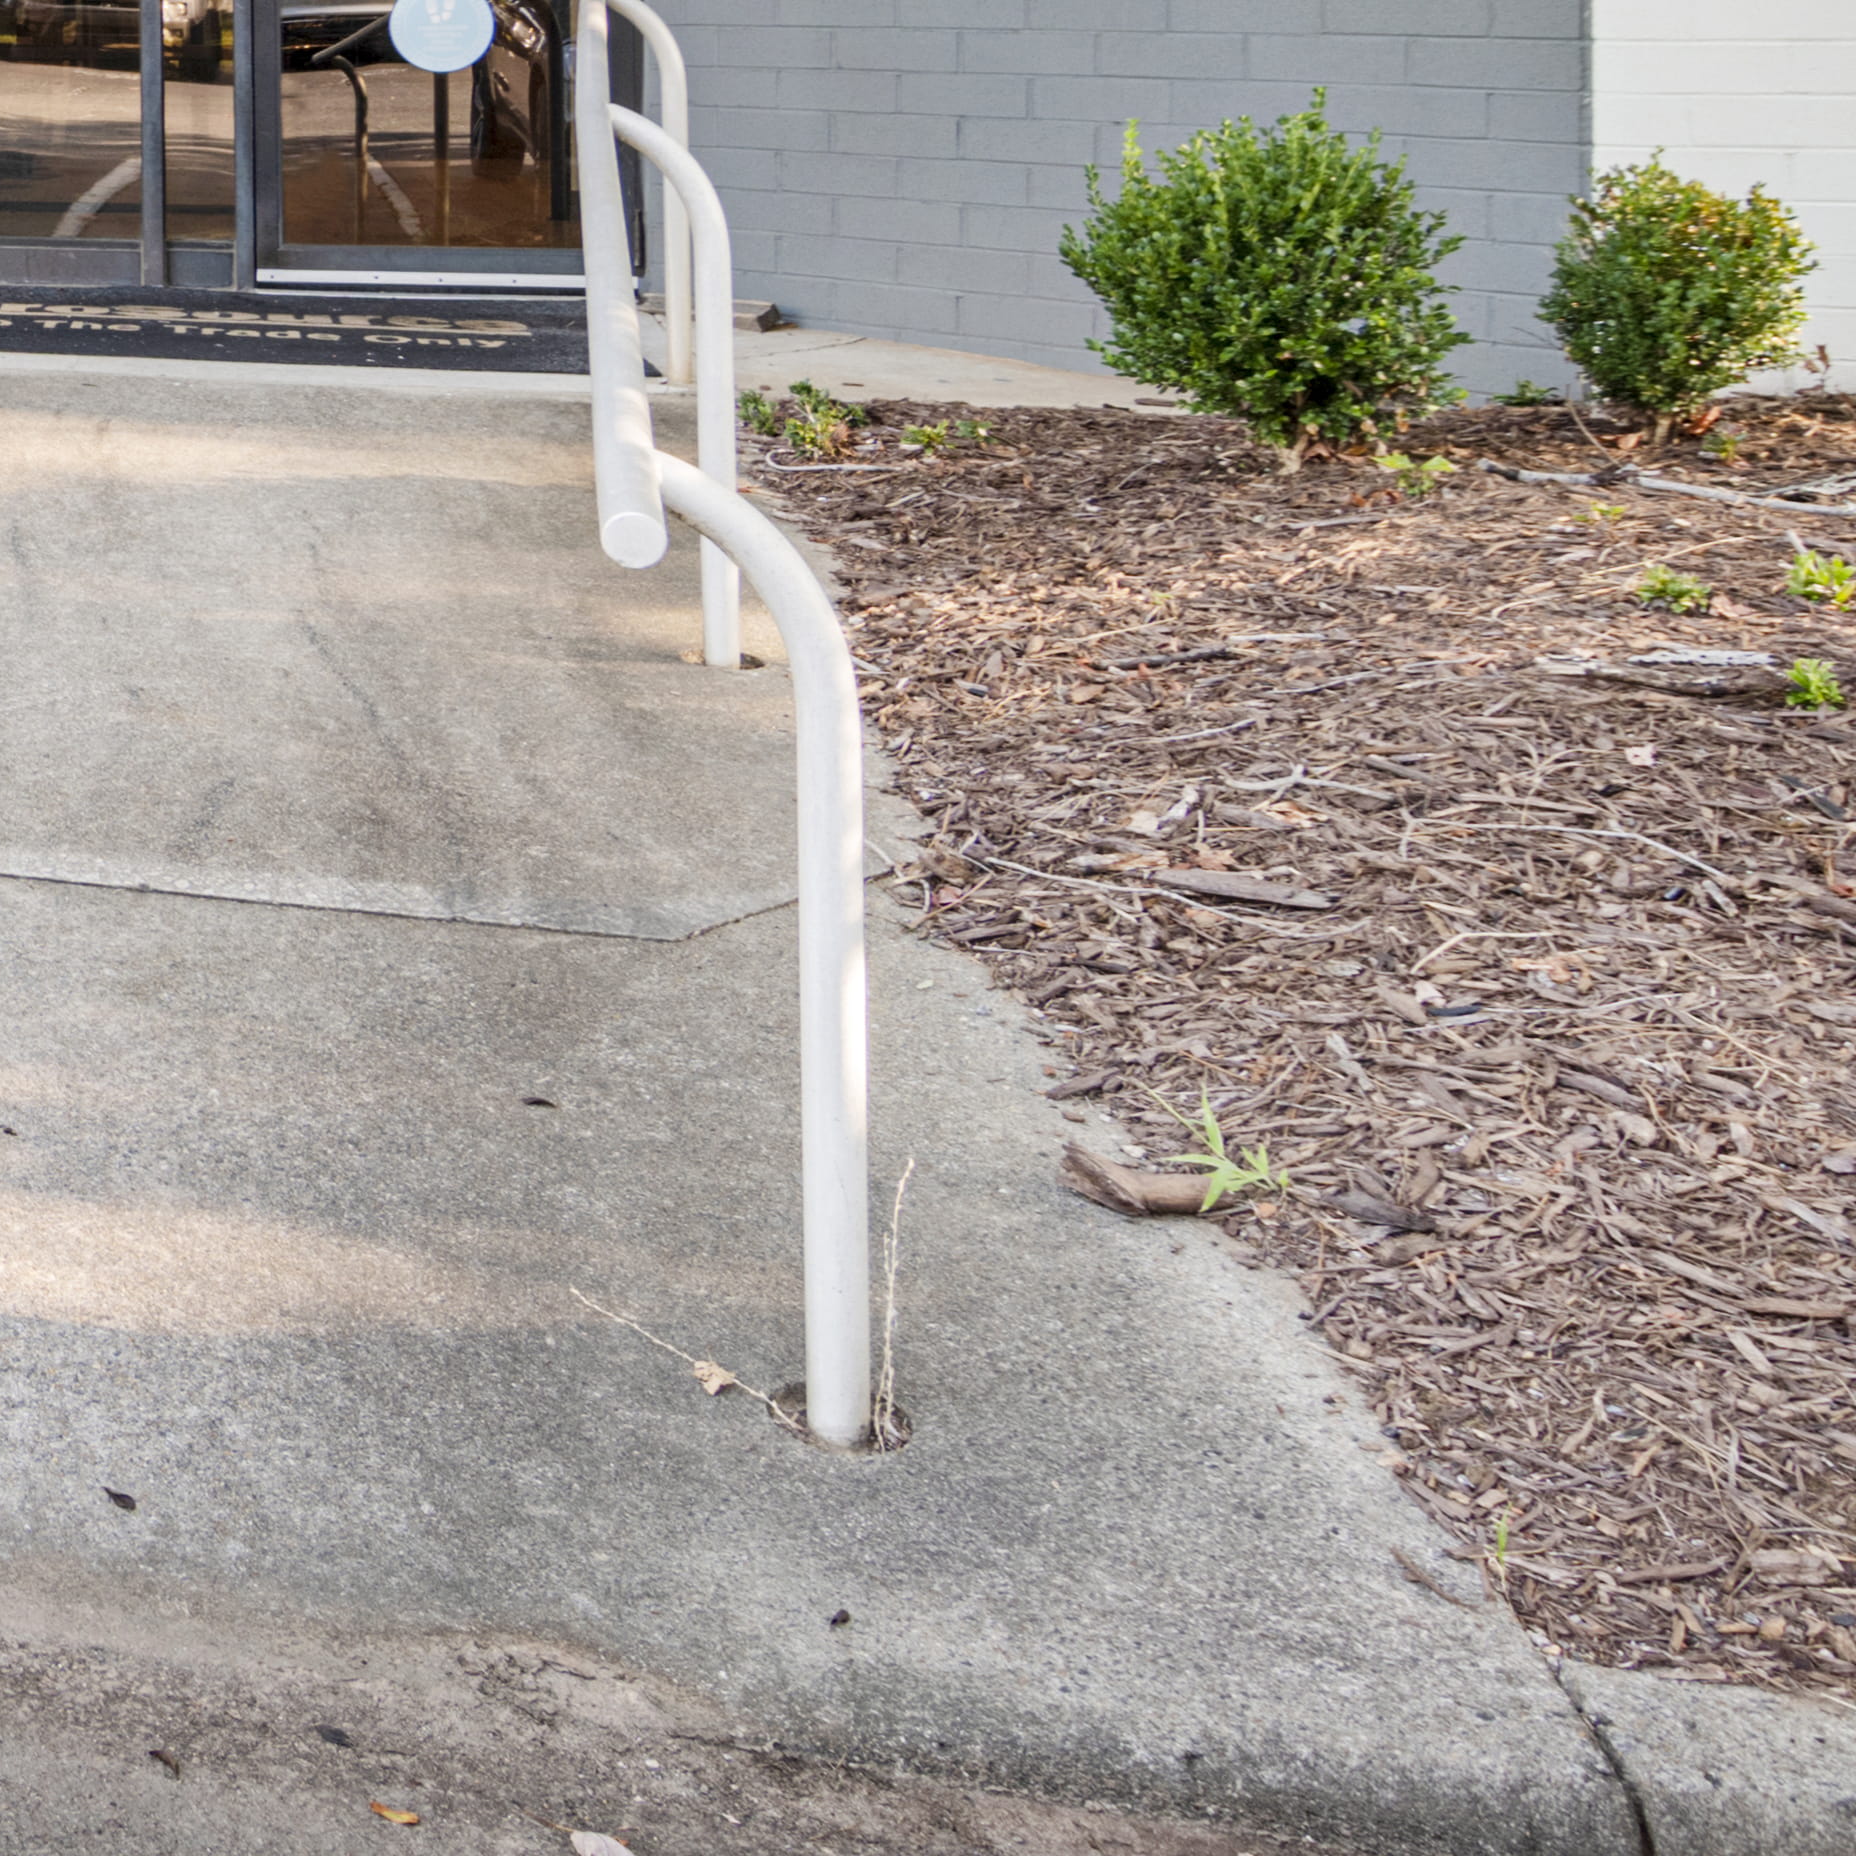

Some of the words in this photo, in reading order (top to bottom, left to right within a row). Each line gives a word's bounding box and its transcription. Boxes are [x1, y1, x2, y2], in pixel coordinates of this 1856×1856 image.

[34, 319, 141, 331] The
[164, 323, 341, 341] Trade
[363, 335, 507, 348] Only
